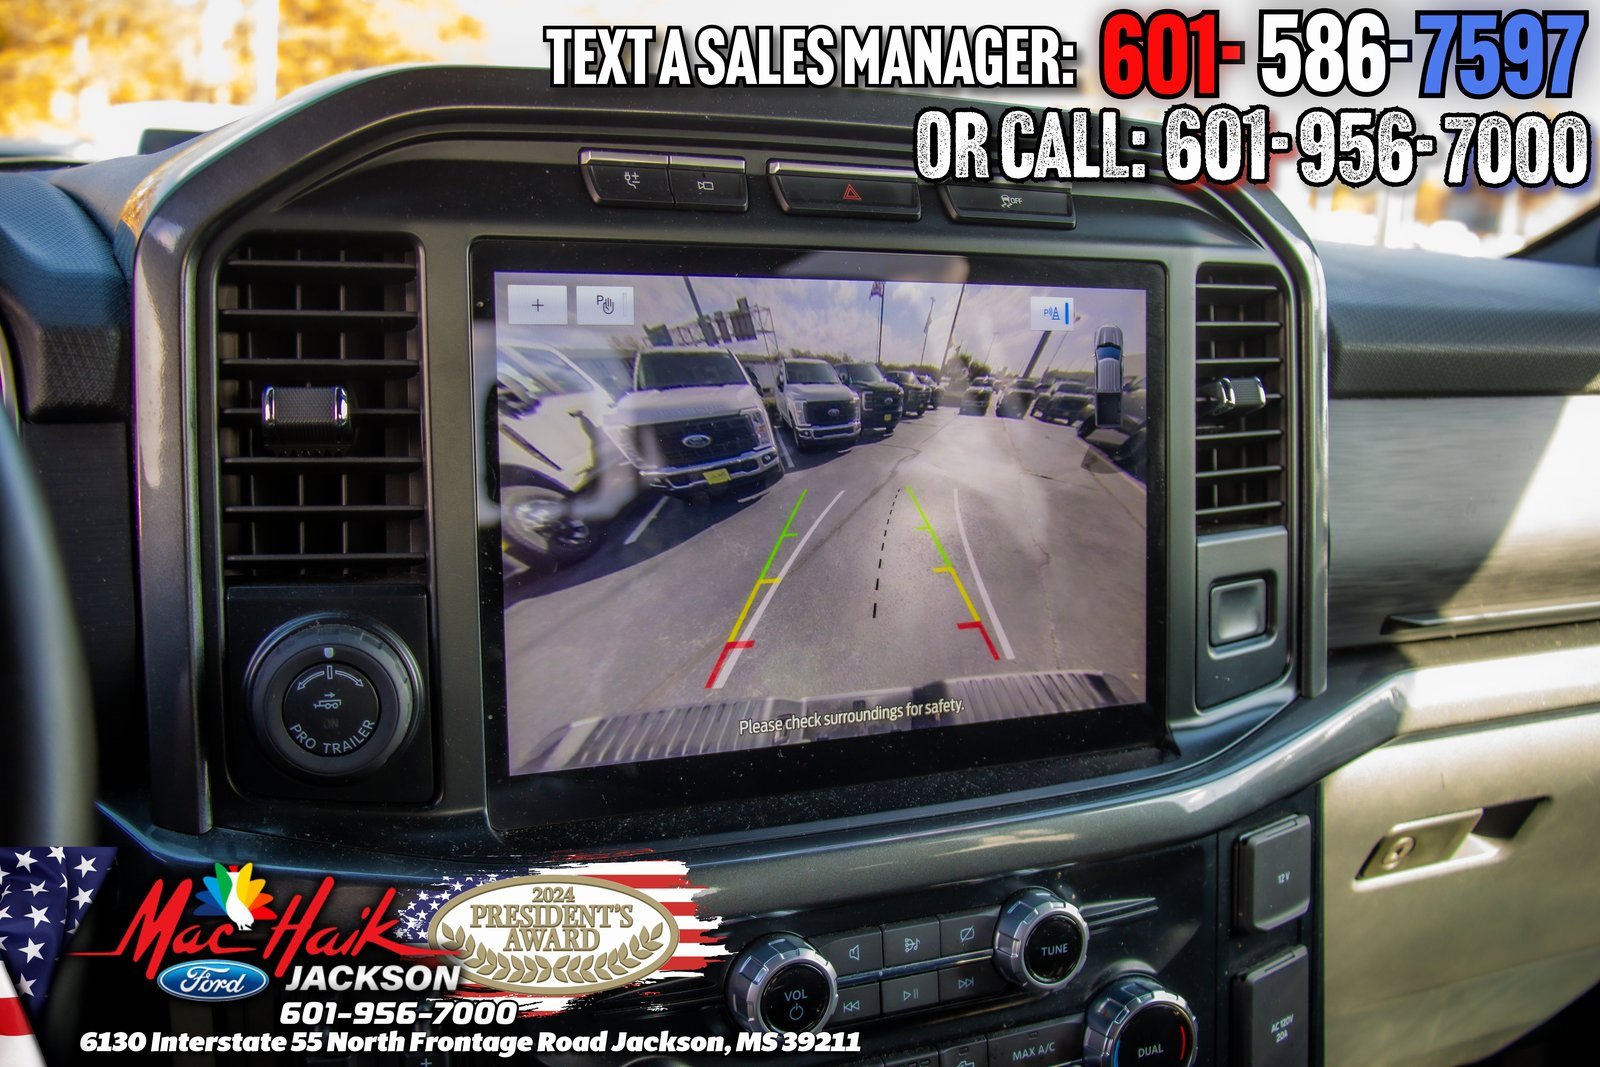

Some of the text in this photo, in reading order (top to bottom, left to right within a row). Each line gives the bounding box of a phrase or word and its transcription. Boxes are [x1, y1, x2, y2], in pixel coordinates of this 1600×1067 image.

[739, 698, 965, 735] Please check surroundings for safety.
[289, 719, 376, 755] PRO TRAILER
[1041, 943, 1069, 956] TUNE
[784, 989, 808, 1001] VOL
[1012, 1042, 1056, 1061] MAX A/C
[1138, 1043, 1164, 1058] DUAL
